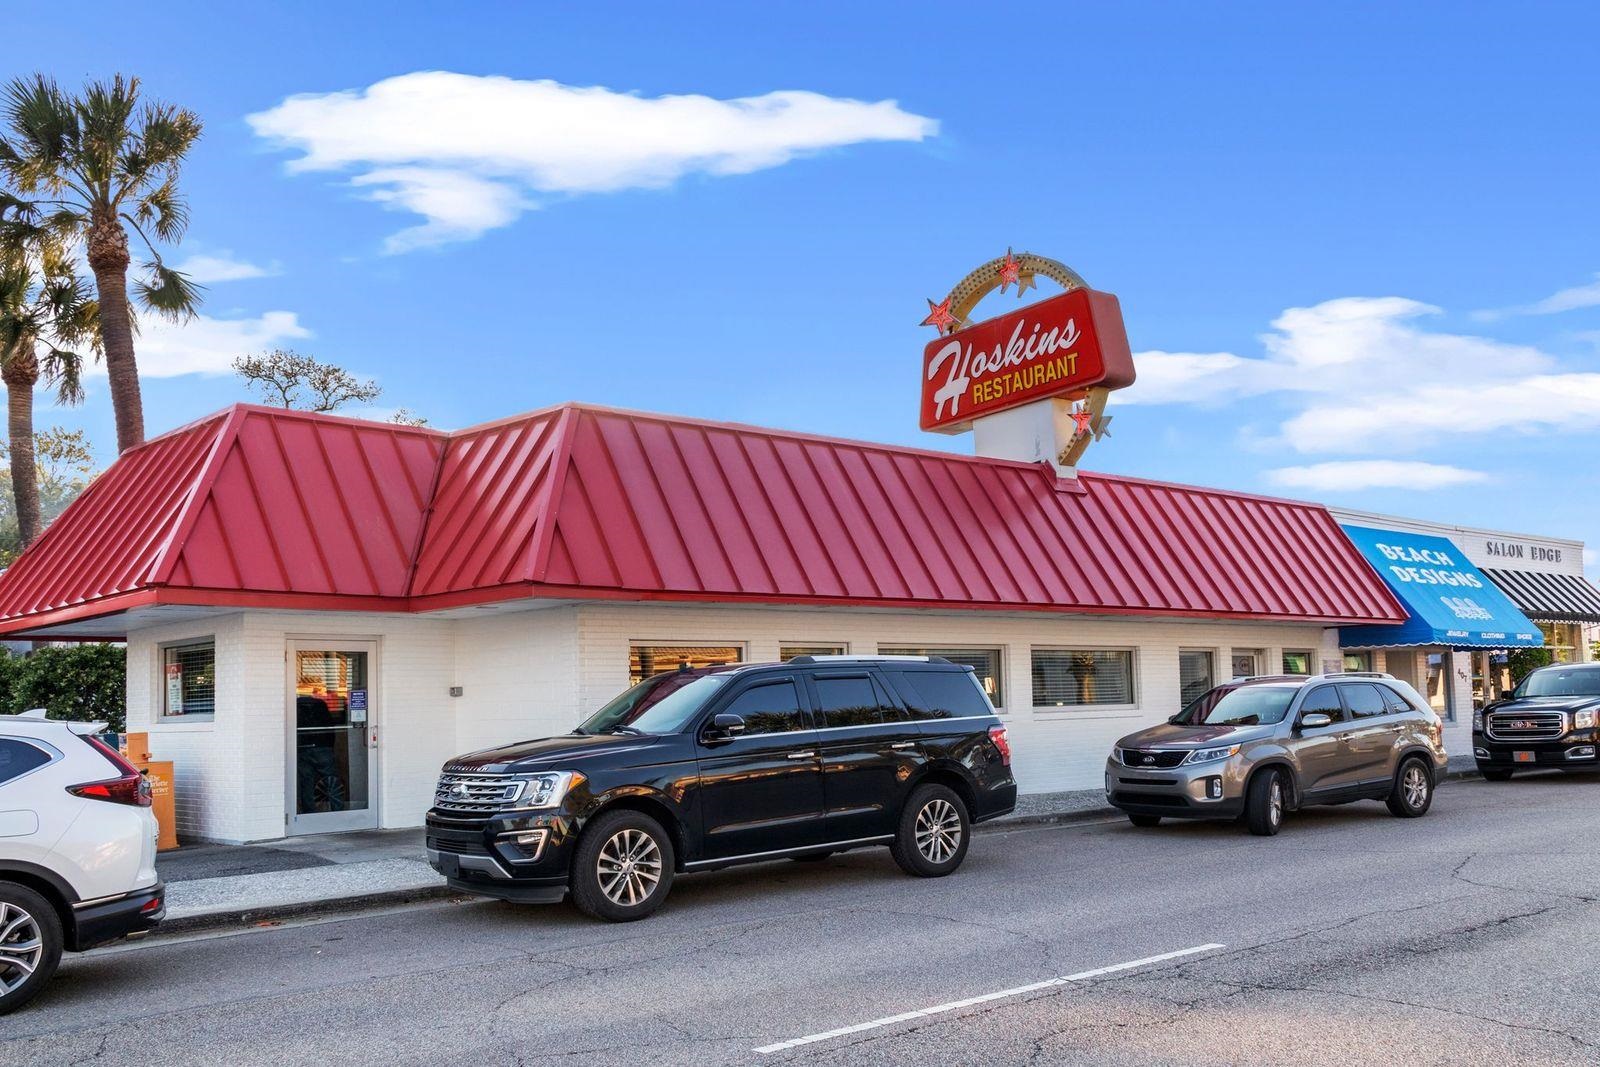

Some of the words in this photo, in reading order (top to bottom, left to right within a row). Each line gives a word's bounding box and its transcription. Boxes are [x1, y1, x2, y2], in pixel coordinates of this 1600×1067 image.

[928, 318, 1081, 421] Hoskins
[973, 352, 1079, 405] RESTAURANT
[1375, 543, 1455, 566] BEACH
[1486, 540, 1524, 558] SALON
[1530, 546, 1562, 562] EDGE
[1390, 565, 1482, 588] DESIGNS
